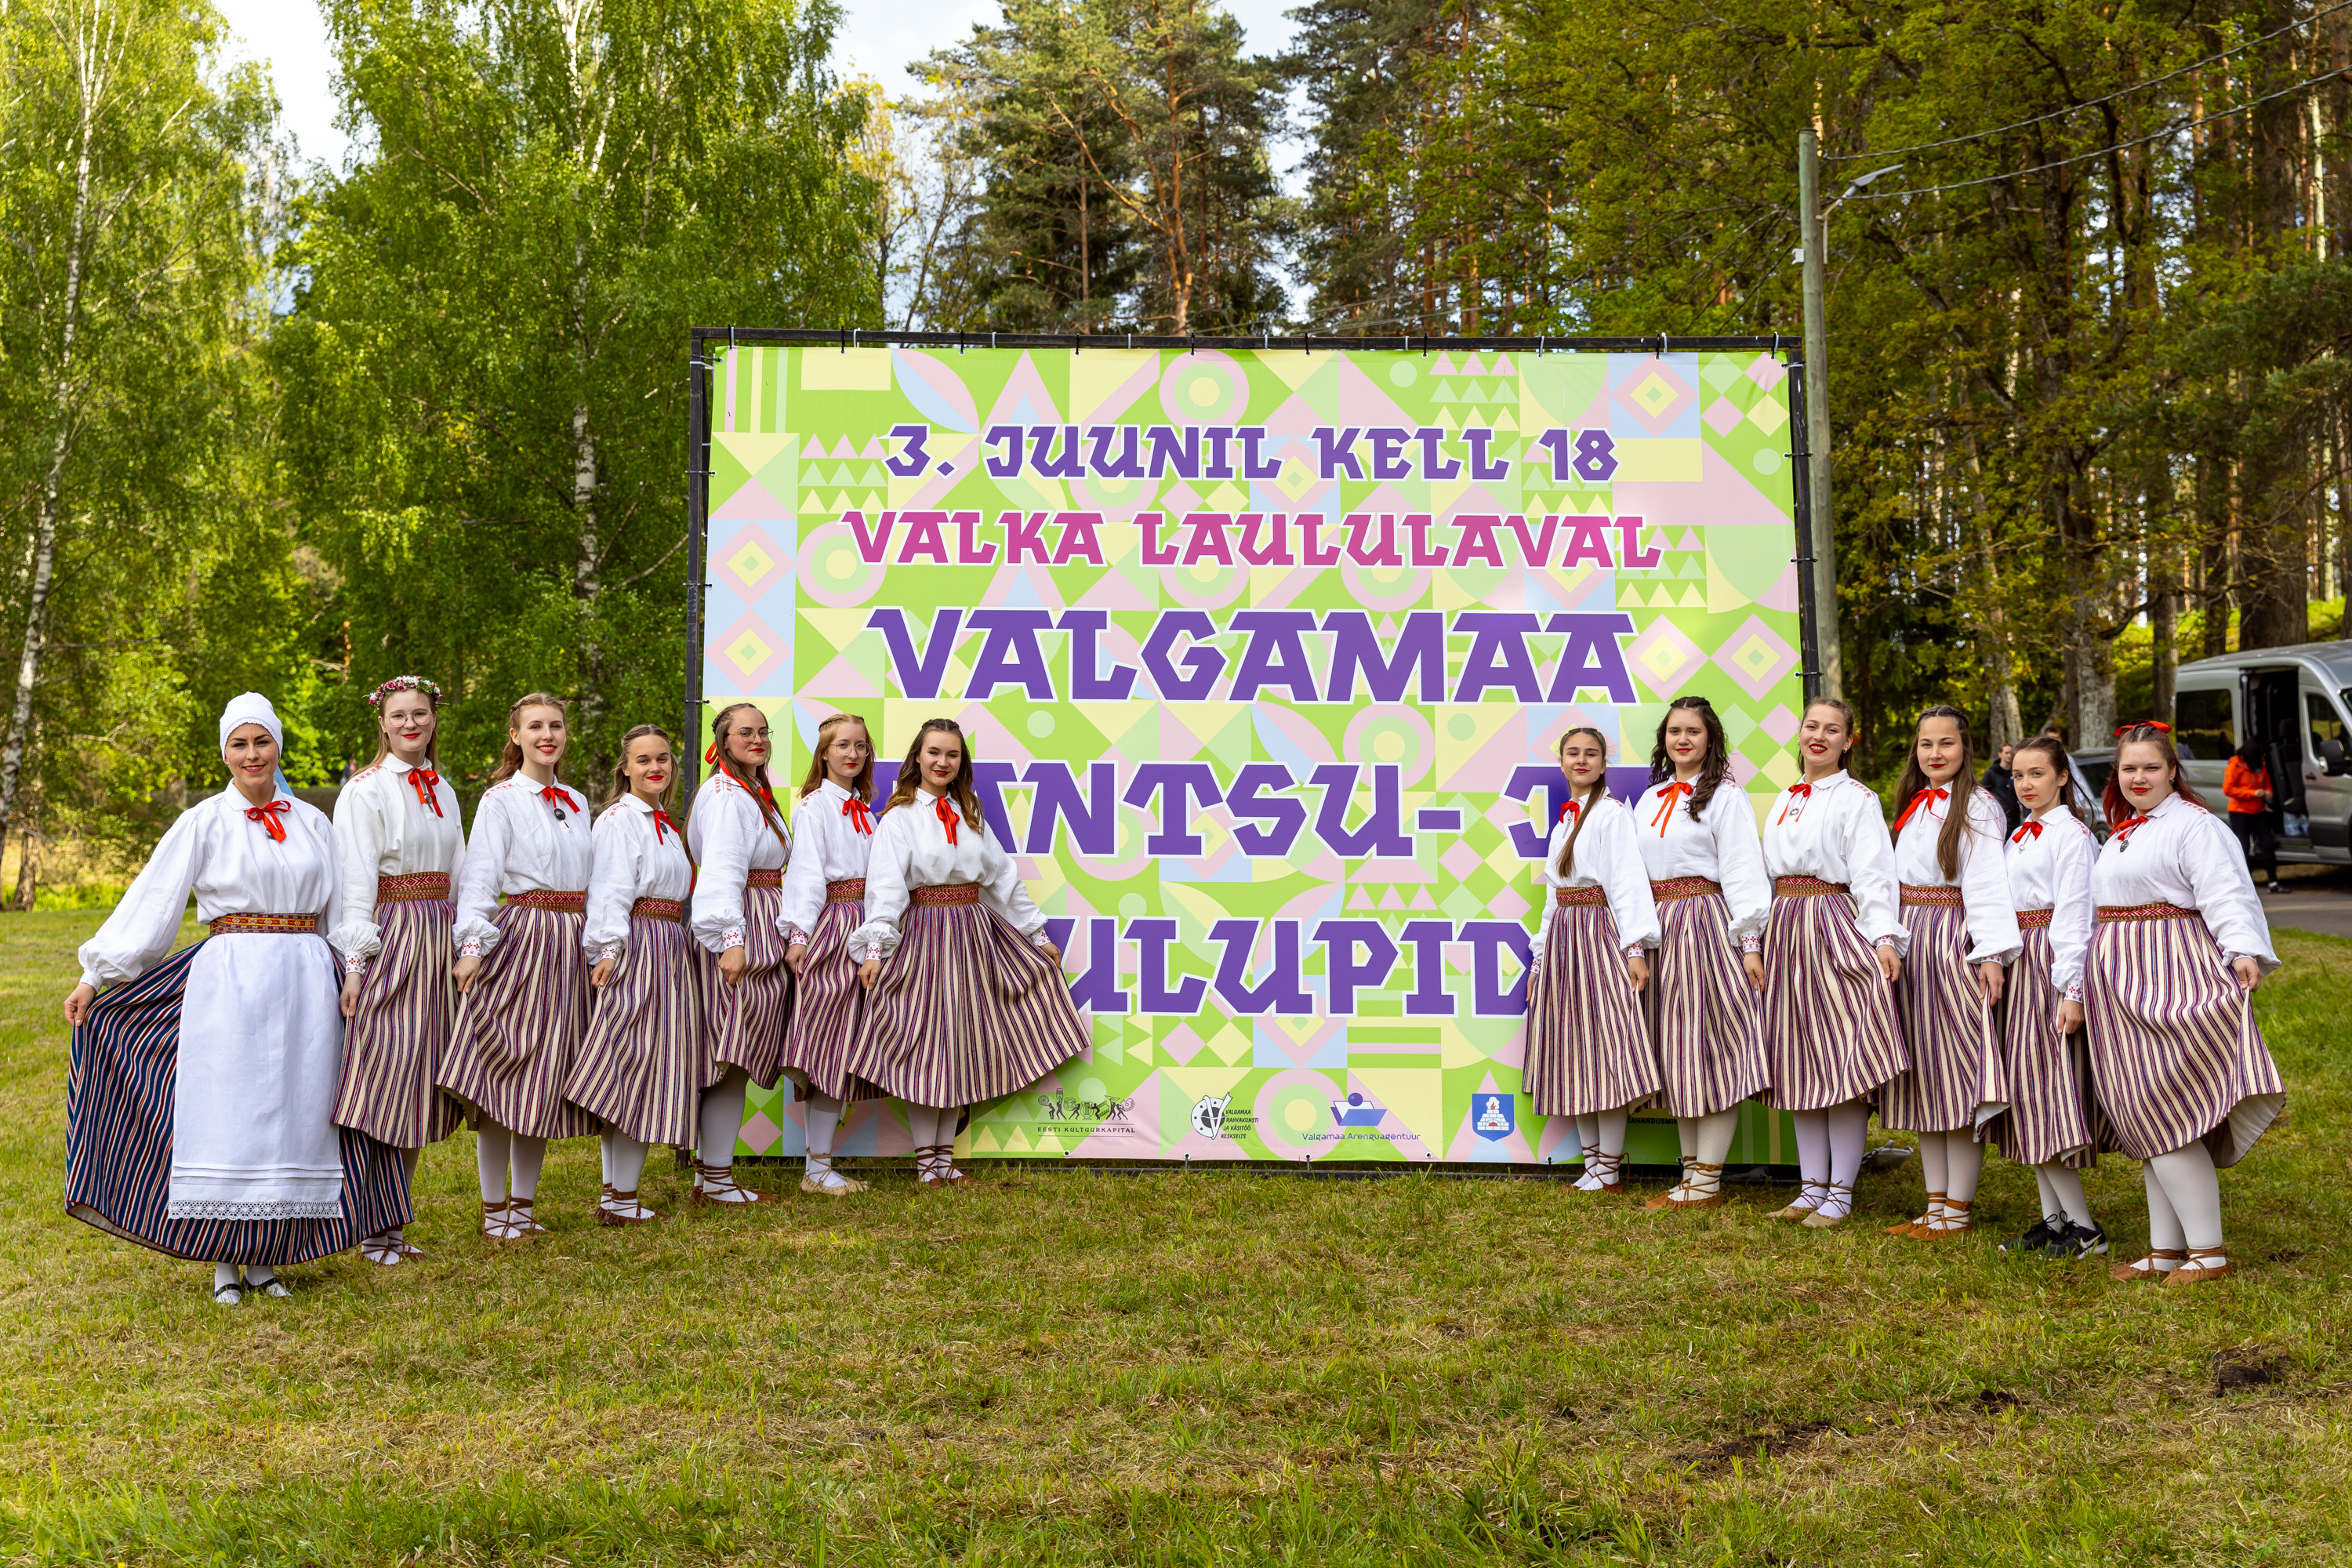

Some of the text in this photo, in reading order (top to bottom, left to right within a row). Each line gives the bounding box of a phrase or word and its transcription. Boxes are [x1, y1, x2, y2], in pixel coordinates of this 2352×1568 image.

[884, 424, 1620, 482] 3. JUUNIL KELL 18
[840, 510, 1663, 569] VALKA LAULULAVAL
[865, 608, 1639, 705] VALGAMAA
[869, 760, 1463, 858] NTSU-
[1045, 916, 1534, 1018] ULUPID
